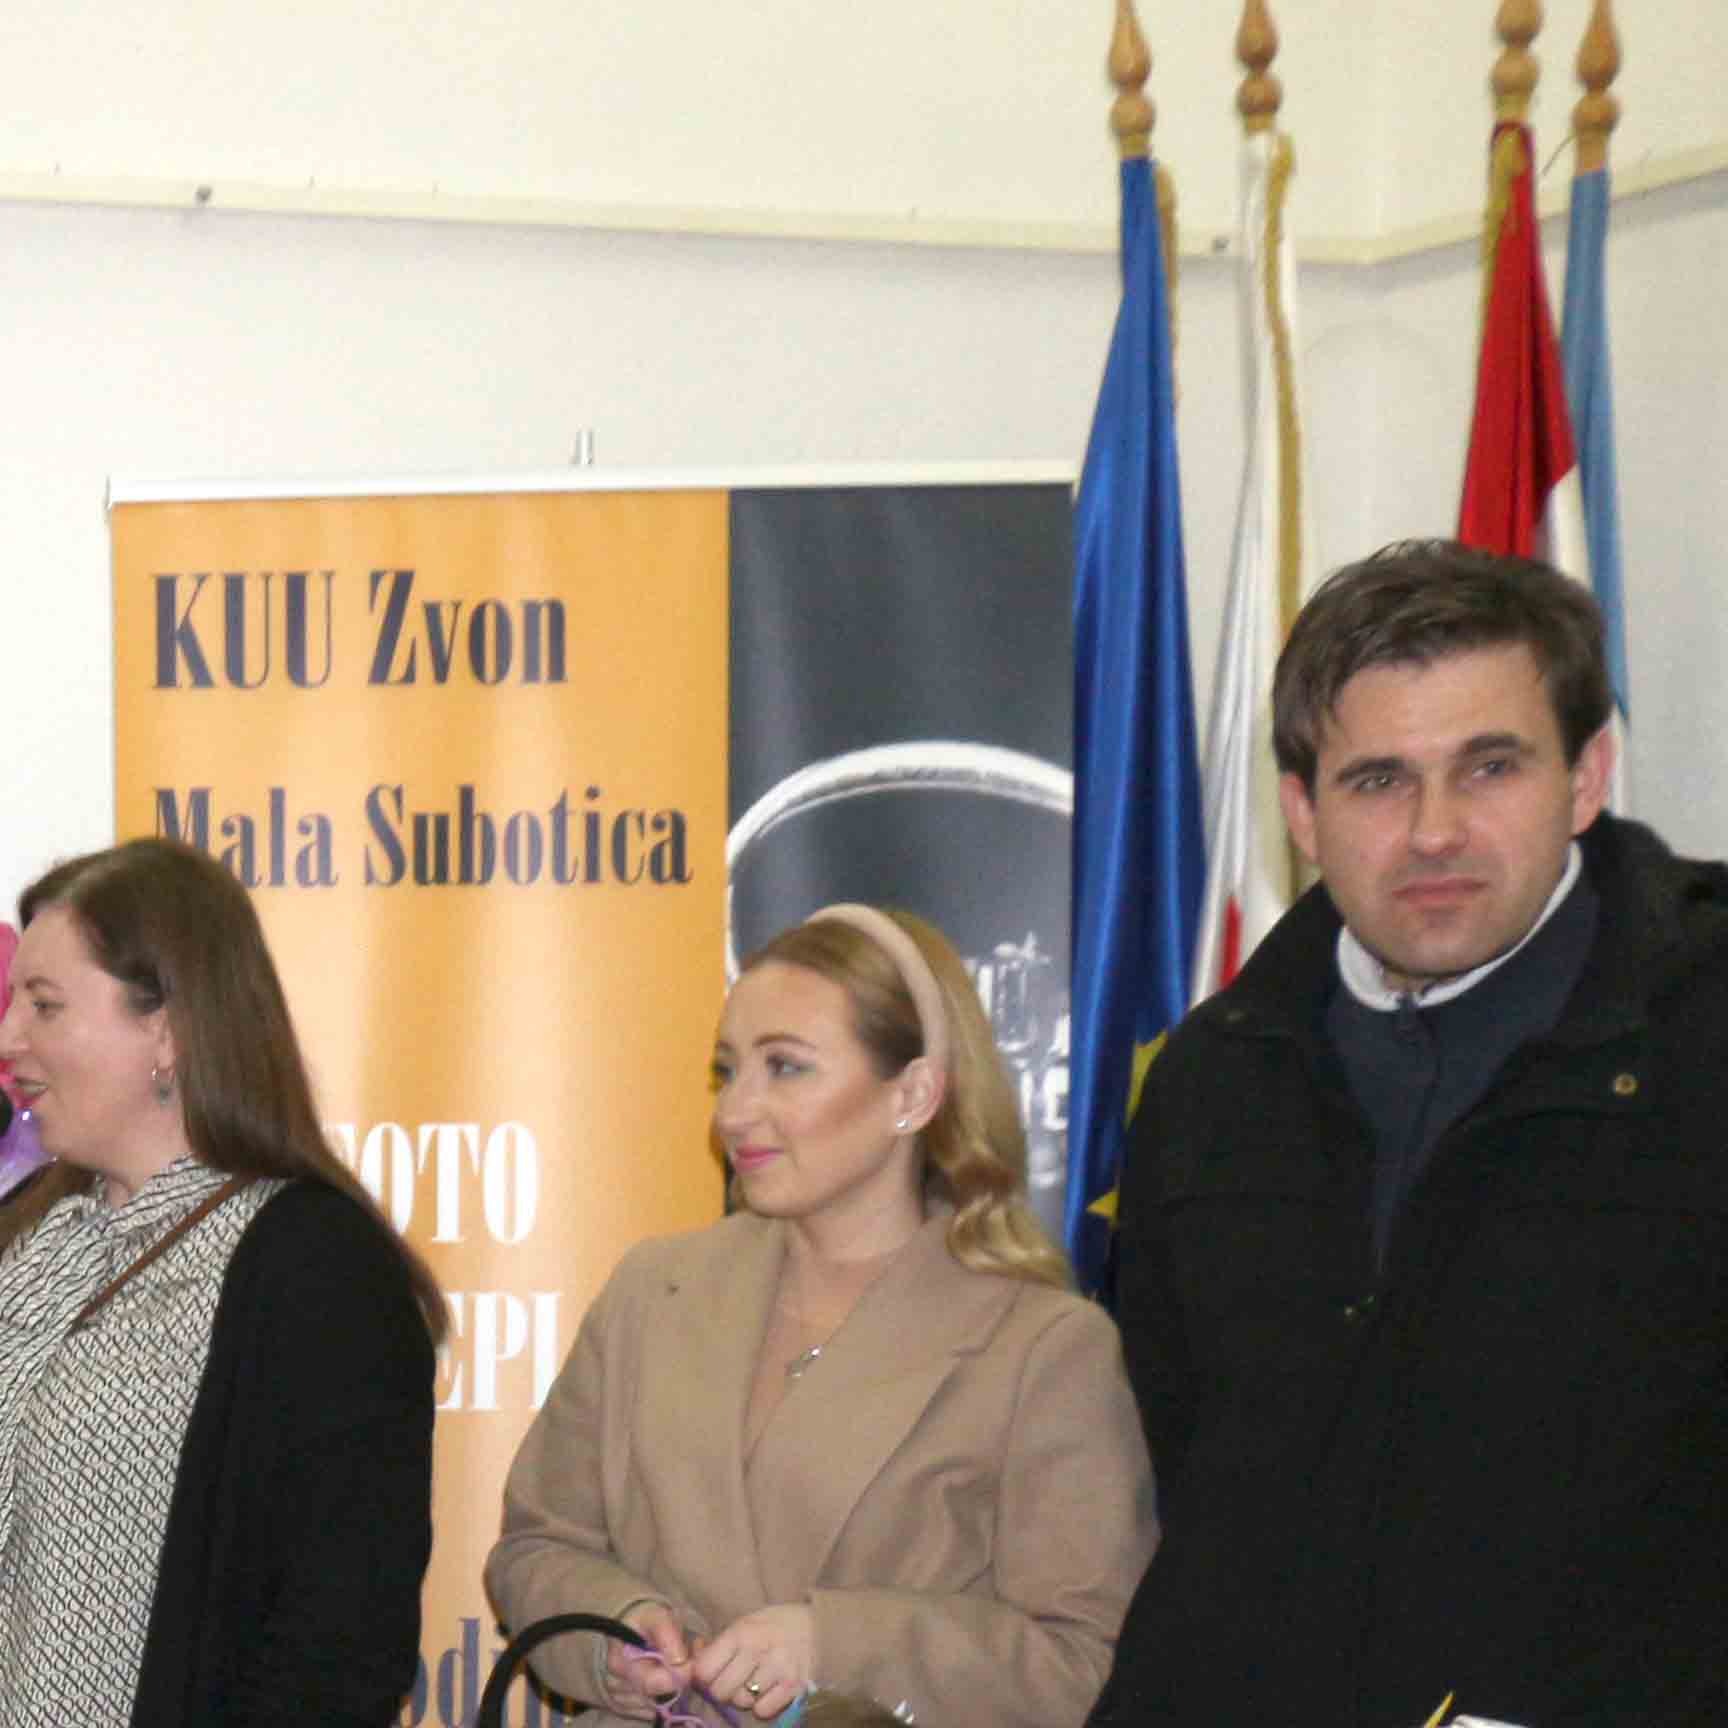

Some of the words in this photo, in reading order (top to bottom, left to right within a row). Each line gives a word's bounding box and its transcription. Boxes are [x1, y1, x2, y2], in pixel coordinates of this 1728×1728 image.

[152, 570, 335, 689] KUU
[366, 568, 569, 687] Zvon
[364, 782, 695, 888] Subotica
